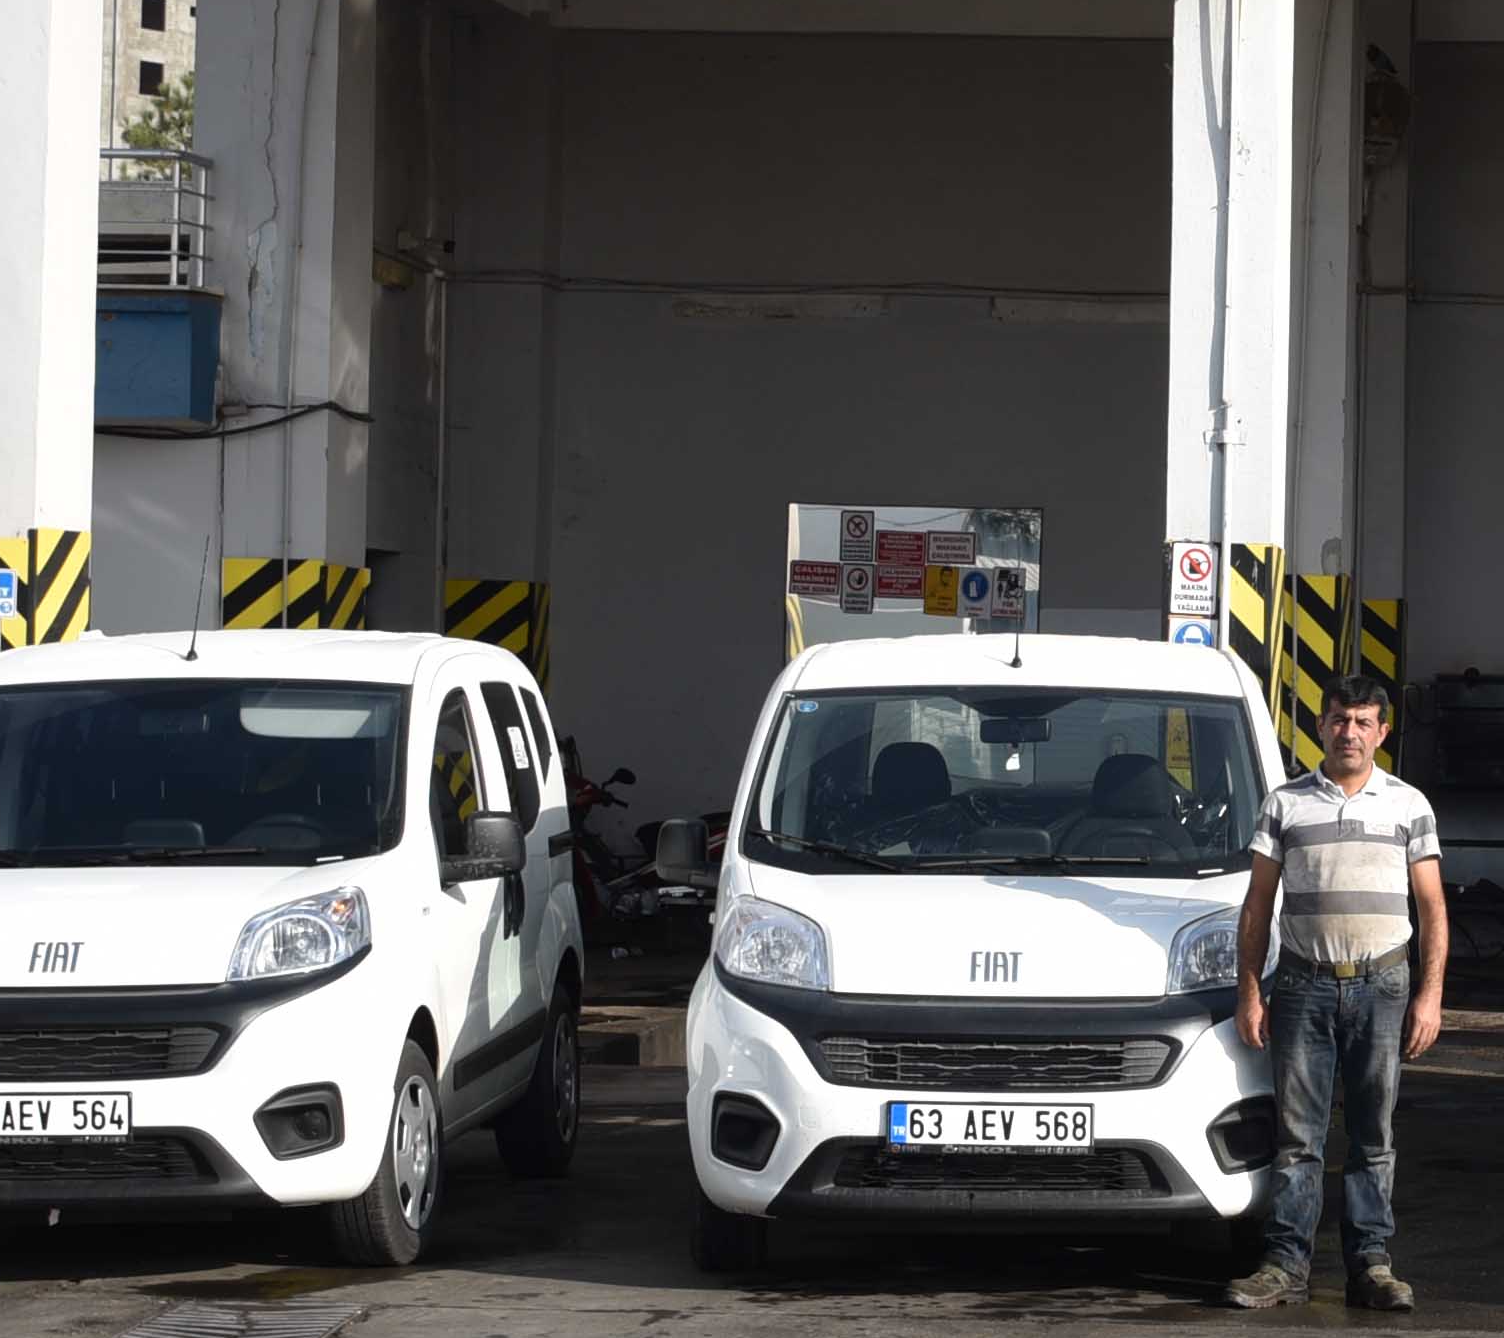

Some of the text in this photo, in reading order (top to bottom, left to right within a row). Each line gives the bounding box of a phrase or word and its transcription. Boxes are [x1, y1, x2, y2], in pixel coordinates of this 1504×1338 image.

[28, 941, 85, 973] FIAT
[969, 951, 1023, 983] FIAT
[2, 1100, 51, 1131] AEV
[72, 1099, 125, 1131] 564
[892, 1109, 1087, 1142] TR 63 AEV 568
